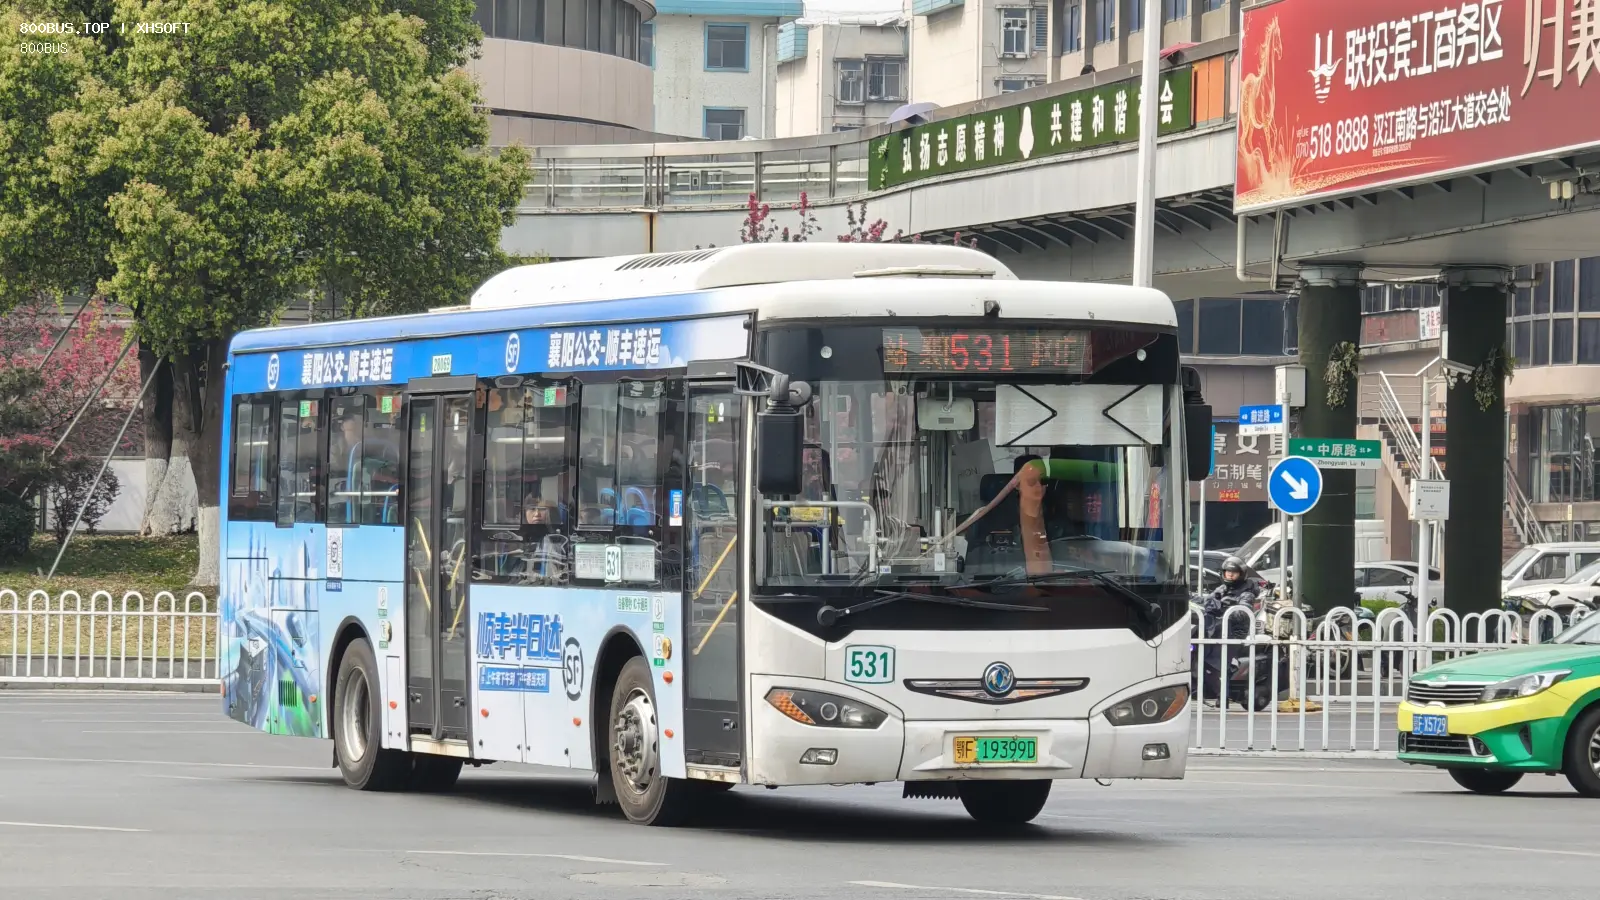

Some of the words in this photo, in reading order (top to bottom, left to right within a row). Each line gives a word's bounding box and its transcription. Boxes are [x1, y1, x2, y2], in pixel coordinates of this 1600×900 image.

[1345, 0, 1503, 91] 联投滨江商务区
[902, 115, 1005, 175] 弘扬志愿精神
[1051, 79, 1174, 147] 共建和谐会
[1310, 122, 1332, 160] 518
[1335, 114, 1369, 156] 8888
[1373, 85, 1511, 147] 汉江南路与沿江大道交会处
[301, 348, 394, 385] 襄阳公交-顺丰速运
[547, 328, 662, 368] 襄阳公交-顺丰速运
[951, 334, 1013, 371] 531
[1317, 459, 1348, 467] Zhongyuan
[1318, 443, 1357, 457] 中原路
[606, 551, 620, 576] 531
[477, 612, 563, 661] 顺丰半日达
[851, 651, 889, 678] 531
